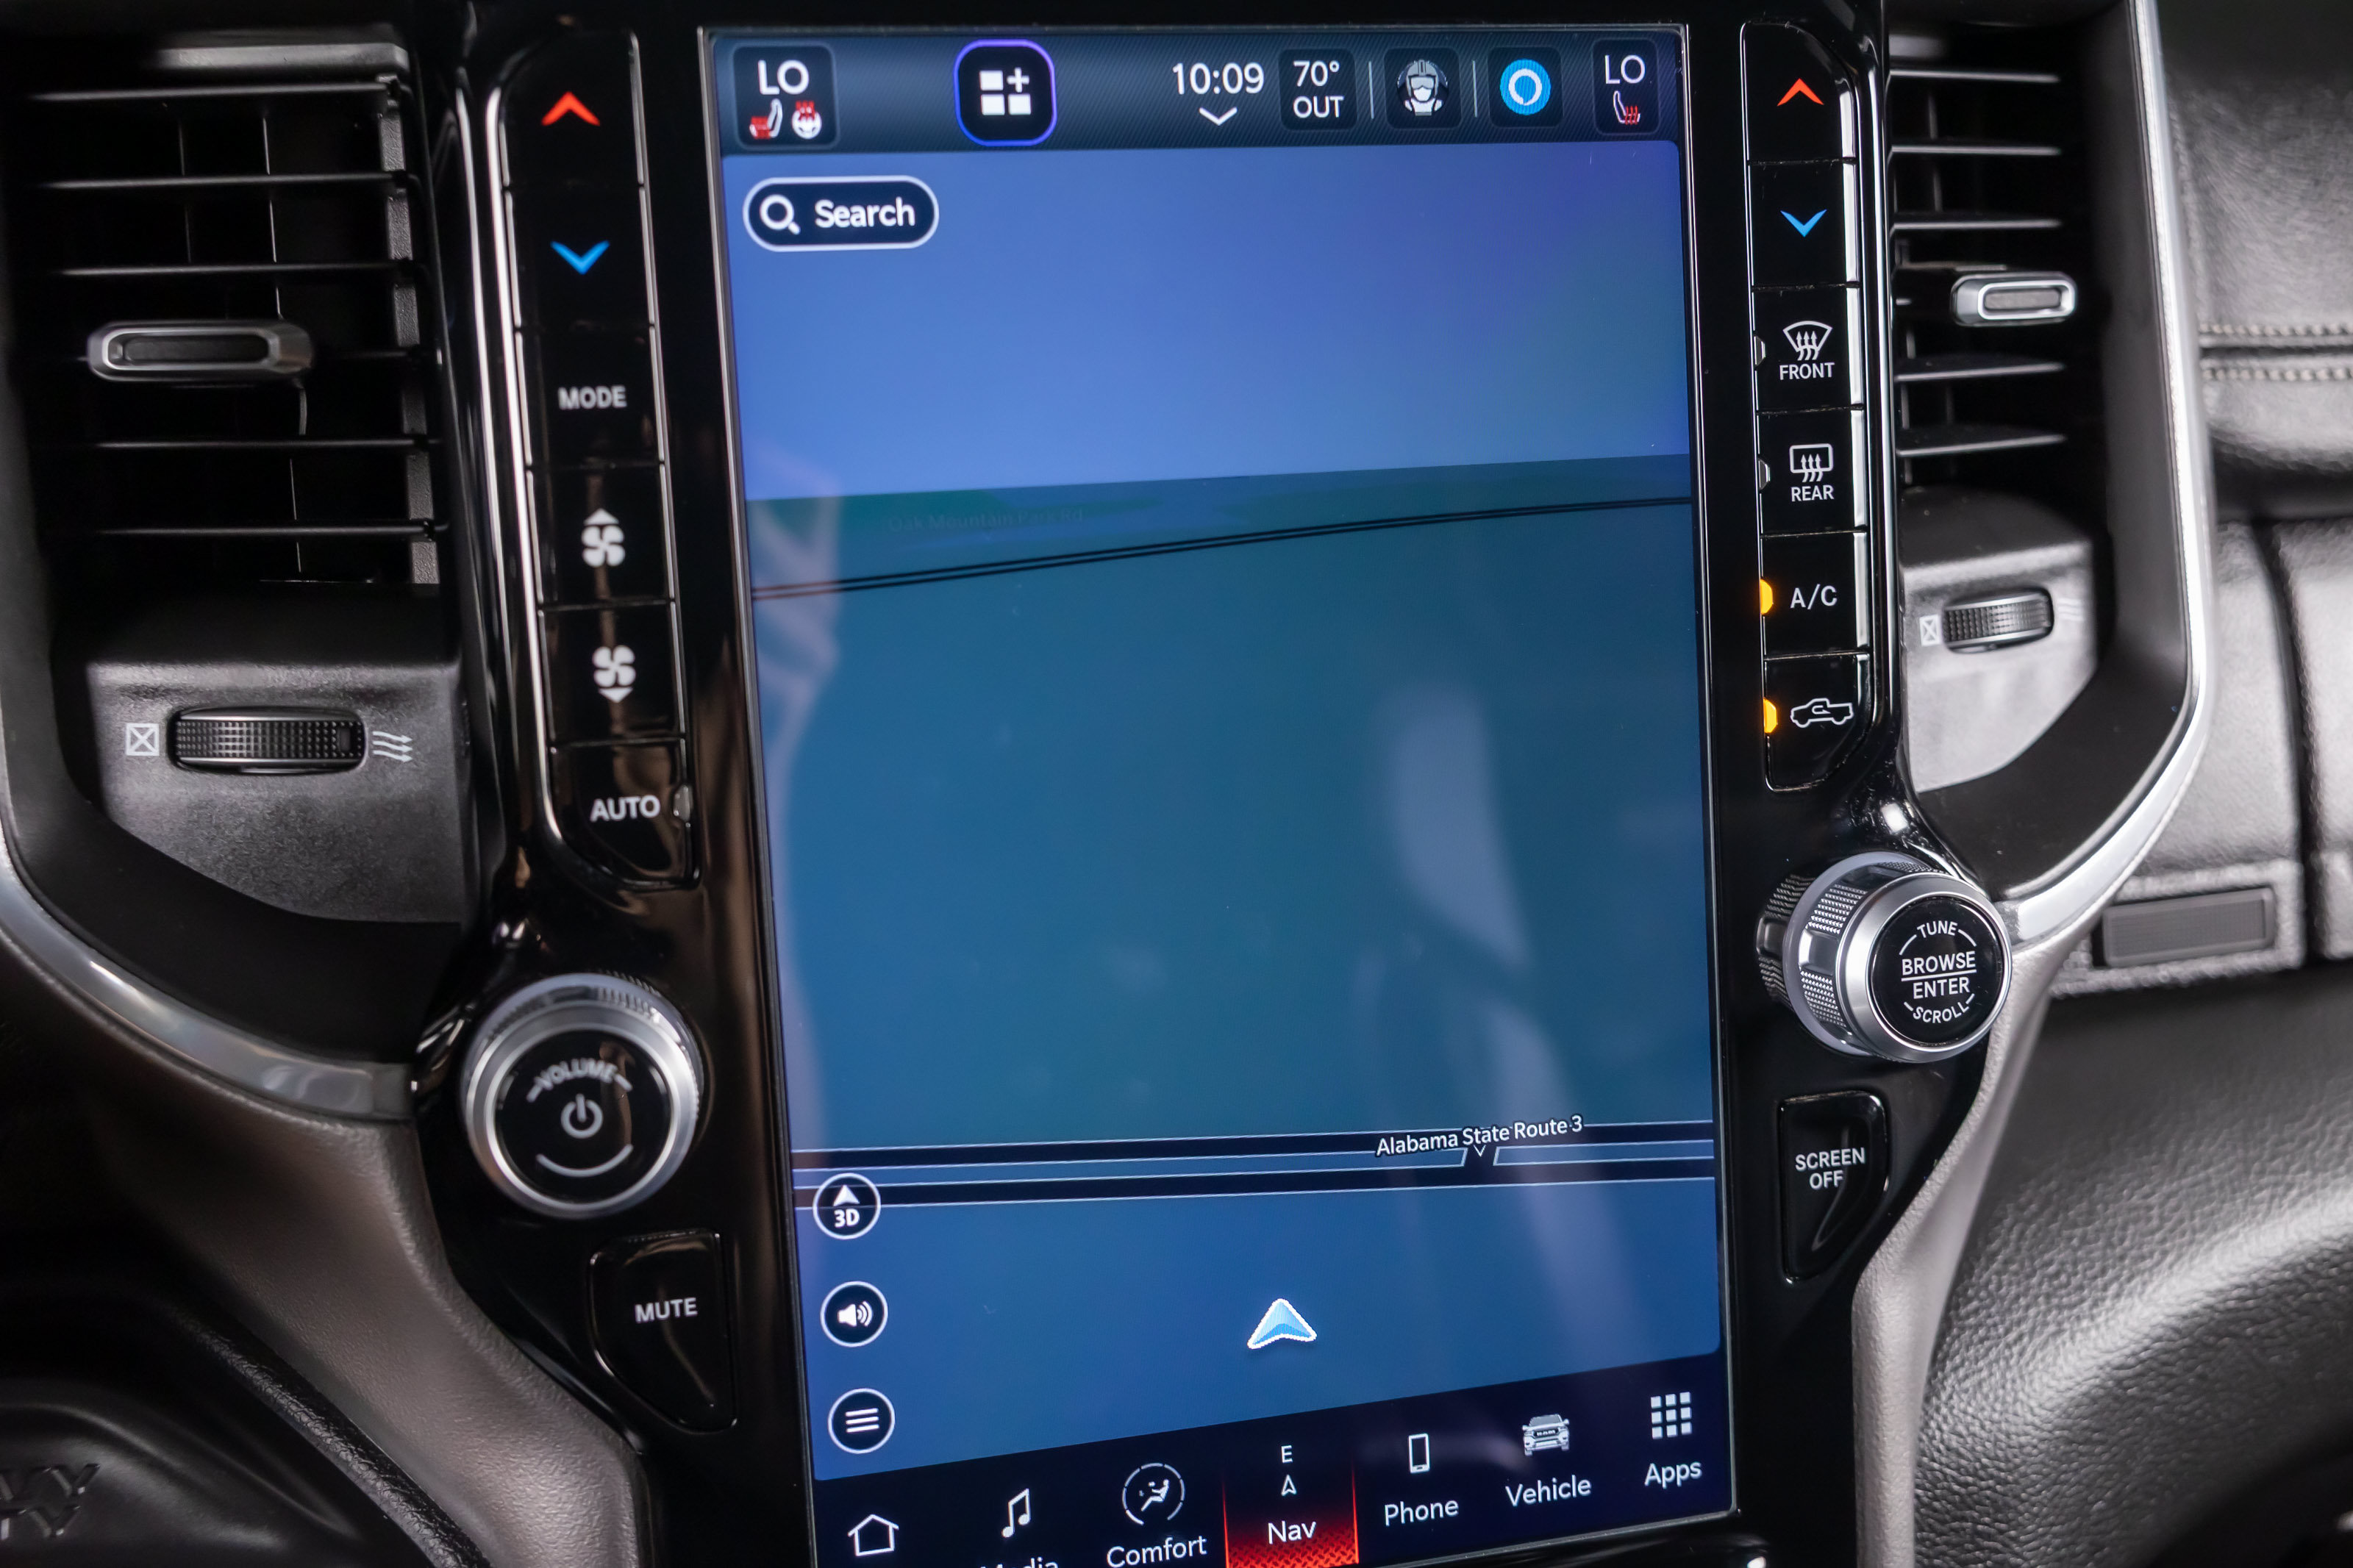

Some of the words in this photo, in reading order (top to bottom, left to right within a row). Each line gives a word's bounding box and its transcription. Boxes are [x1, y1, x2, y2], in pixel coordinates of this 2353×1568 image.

[757, 59, 810, 96] LO
[1171, 61, 1265, 96] 10:09
[1293, 60, 1340, 87] 70°
[1604, 54, 1646, 85] LO
[1293, 96, 1344, 119] OUT
[814, 197, 916, 229] Search
[1779, 362, 1835, 380] FRONT
[557, 384, 627, 410] MODE
[1790, 484, 1835, 502] REAR
[1790, 584, 1838, 609] A/C
[590, 795, 660, 823] AUTO
[1916, 920, 1957, 938] TUNE
[1902, 951, 1977, 975] BROWSE
[1913, 977, 1970, 999] ENTER
[1913, 1001, 1970, 1023] SCROLL
[534, 1057, 618, 1090] VOLUME
[1375, 1133, 1459, 1157] Alabama
[1463, 1125, 1510, 1145] State
[1514, 1118, 1568, 1139] Route
[1571, 1114, 1583, 1133] 3
[1795, 1147, 1865, 1172] SCREEN
[1809, 1170, 1843, 1190] OFF
[834, 1208, 860, 1228] 3D
[635, 1297, 698, 1323] MUTE
[1281, 1445, 1293, 1463] E
[1644, 1461, 1703, 1489] Apps
[1504, 1475, 1592, 1508] Vehicle
[1385, 1498, 1460, 1527] Phone
[1268, 1520, 1317, 1545] Nav
[1107, 1536, 1207, 1568] Comfort
